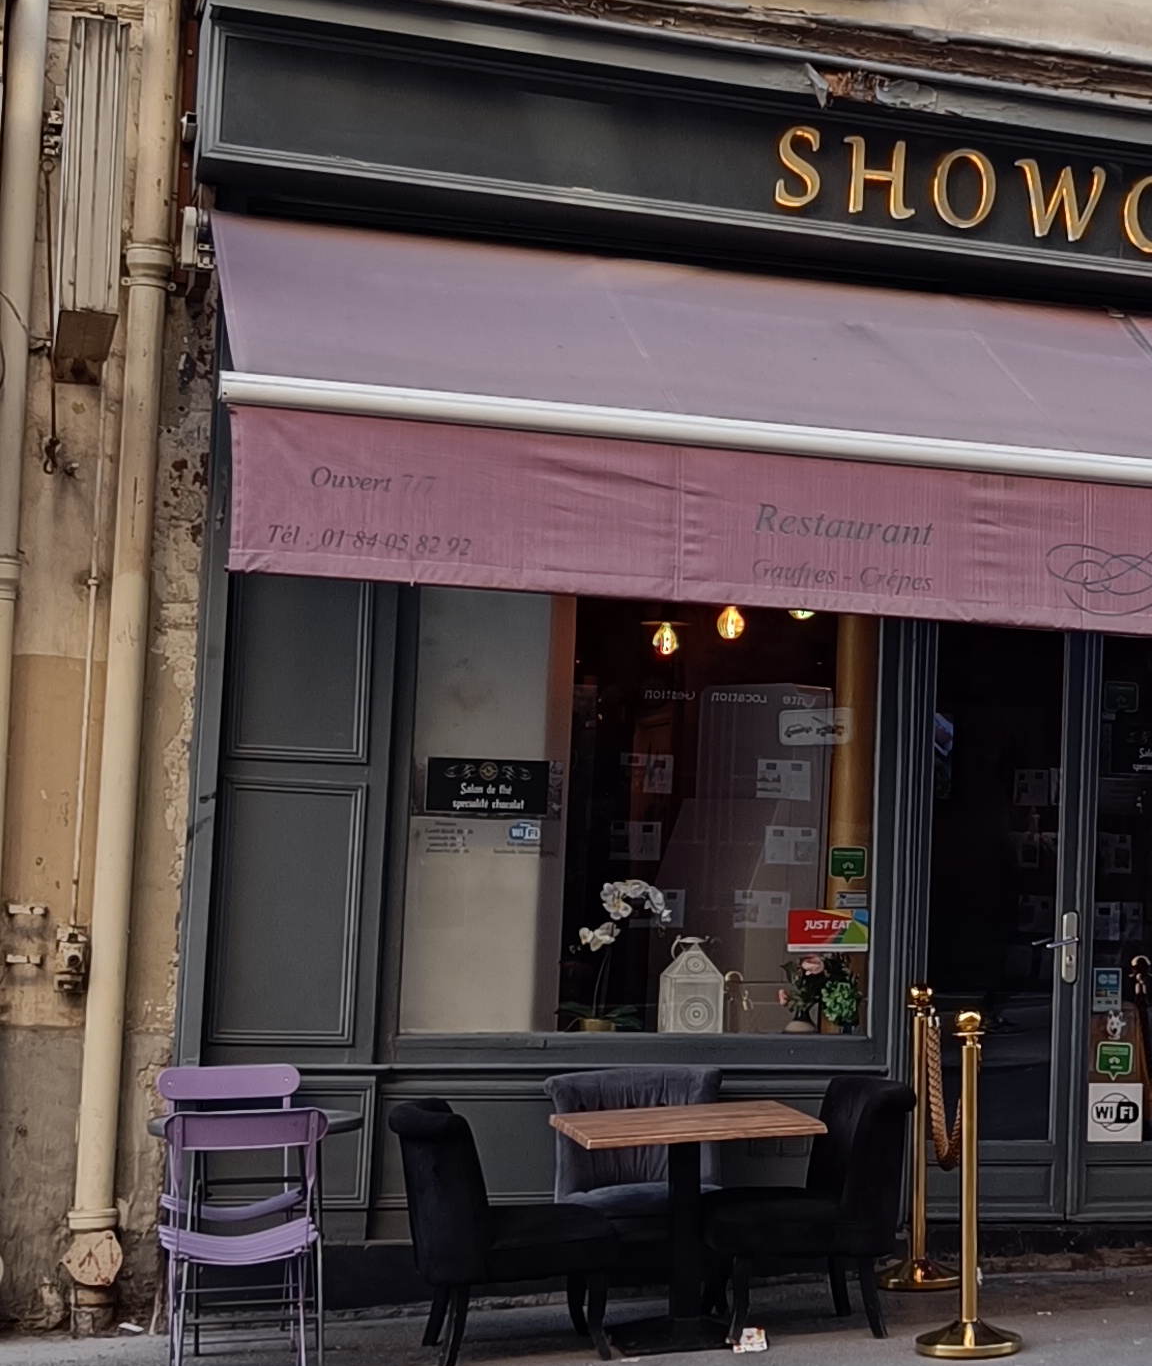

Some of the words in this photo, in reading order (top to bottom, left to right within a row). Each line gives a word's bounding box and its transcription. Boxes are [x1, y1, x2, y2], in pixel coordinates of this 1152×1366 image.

[310, 466, 393, 493] Ouvert
[401, 473, 438, 494] 7/7
[754, 503, 934, 546] Restaurant
[321, 527, 346, 548] 01
[352, 530, 379, 549] 84
[385, 532, 409, 551] 05
[415, 535, 441, 555] 82
[447, 537, 472, 556] 92
[752, 558, 838, 587] Gaufres
[460, 782, 484, 795] Salon
[486, 784, 496, 794] de
[492, 798, 525, 810] chocolat
[804, 920, 831, 931] JUST
[831, 920, 852, 930] EAT
